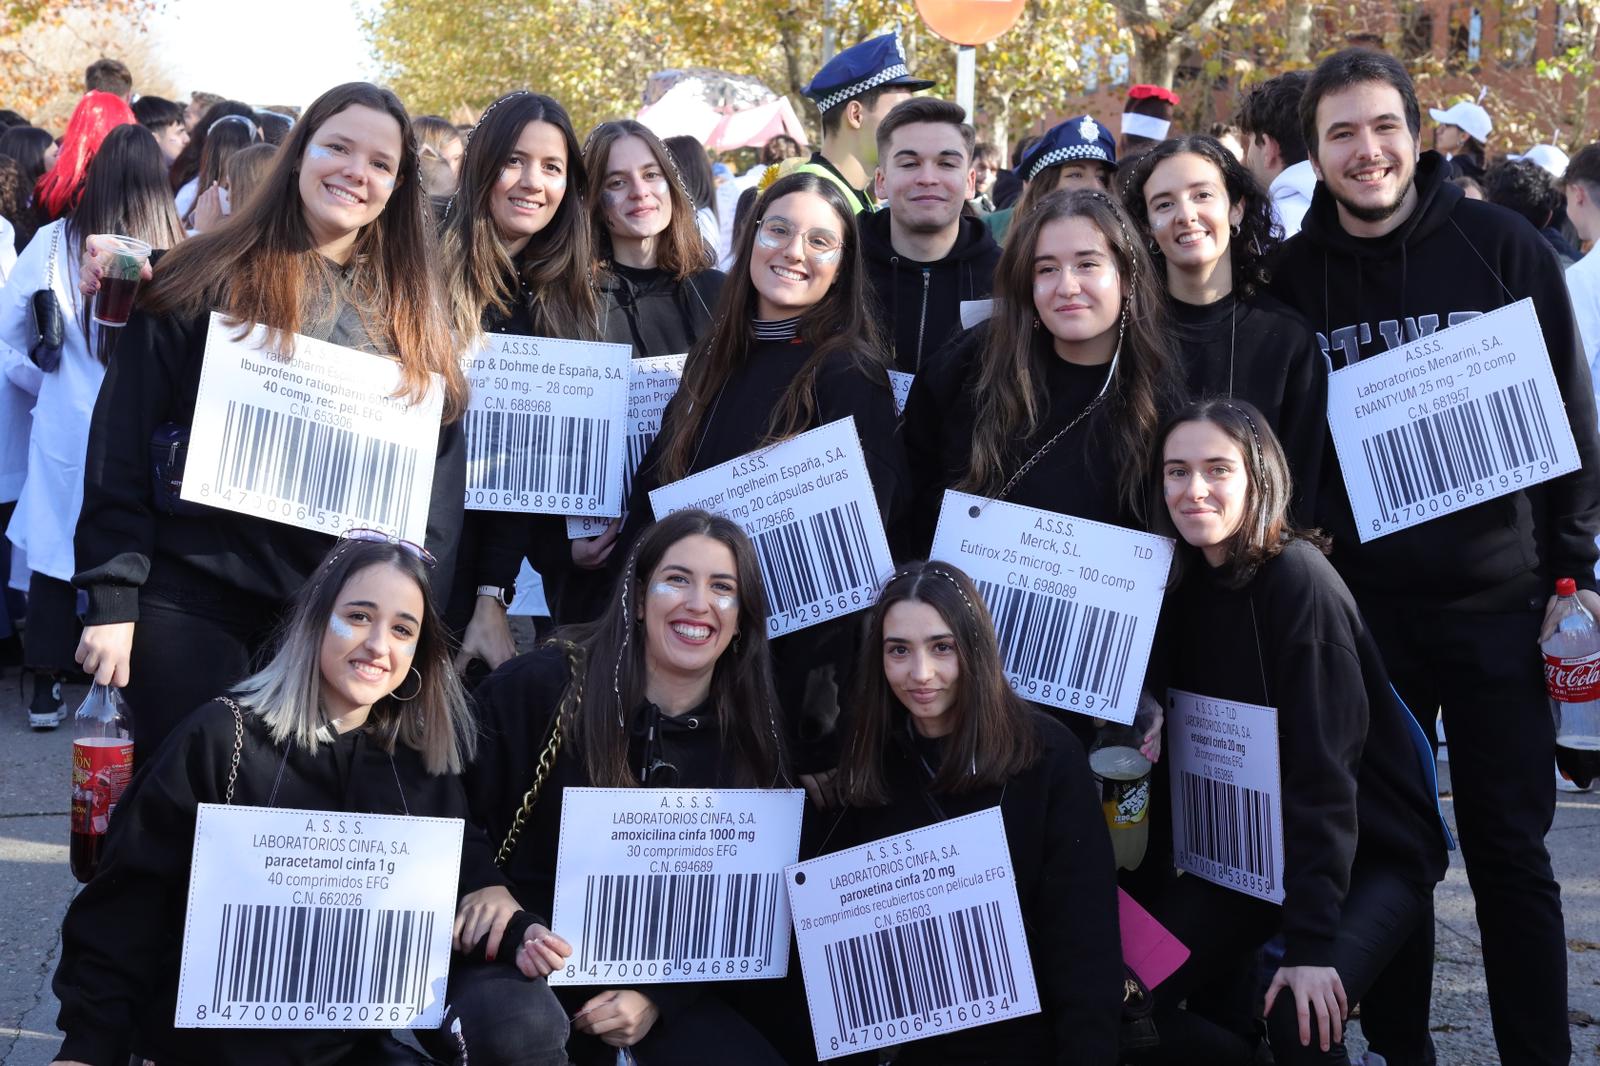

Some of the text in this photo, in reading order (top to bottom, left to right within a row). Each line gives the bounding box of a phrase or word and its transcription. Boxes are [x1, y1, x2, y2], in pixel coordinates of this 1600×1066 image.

[501, 342, 540, 356] A.S.S.S.
[1406, 340, 1443, 362] A.S.S.S.
[488, 359, 496, 370] &
[500, 359, 539, 373] Dohme
[542, 362, 556, 374] de
[560, 364, 601, 380] España,
[605, 368, 624, 379] S.A.
[1357, 335, 1502, 398] Laboratorios Menarini, S.A.
[240, 358, 303, 384] Ibuprofeno
[305, 378, 365, 401] ratiopharm
[494, 378, 509, 389] 50
[512, 381, 532, 394] mg.
[546, 382, 560, 394] 28
[563, 384, 594, 398] comp
[1355, 386, 1417, 418] ENANTYUM
[1419, 383, 1434, 394] 25
[1435, 377, 1454, 391] mg
[1467, 364, 1482, 377] 20
[1485, 352, 1516, 375] comp
[263, 381, 277, 393] 40
[280, 386, 313, 406] comp.
[316, 395, 337, 409] rec.
[339, 402, 359, 418] pel.
[485, 397, 551, 412] C.N. 688968
[1408, 387, 1470, 420] C.N. 681957
[290, 404, 352, 429] C.N. 653306
[638, 421, 658, 432] C.N.
[732, 457, 768, 479] A.S.S.S.
[669, 447, 847, 516] hringer Ingelheim España, S.A.
[732, 506, 749, 522] mg
[751, 497, 764, 514] 20
[766, 482, 815, 508] cápsulas
[816, 469, 848, 490] duras
[1034, 518, 1074, 537] A.S.S.S.
[1020, 532, 1081, 557] Merck, S.L.
[1133, 545, 1152, 560] TLD
[960, 540, 1000, 561] Eutirox
[1002, 550, 1017, 564] 25
[1020, 555, 1062, 576] microg.
[1079, 566, 1099, 582] 100
[1102, 574, 1135, 591] comp
[1007, 572, 1077, 599] C.N. 698089
[1213, 737, 1226, 749] cinfa
[1228, 740, 1235, 751] 20
[1236, 744, 1245, 756] mg
[613, 813, 756, 825] LABORATORIOS CINFA, S.A.
[253, 835, 410, 855] LABORATORIOS CINFA, S.A.
[611, 829, 755, 842] amoxicilina cinfa 1000 mg
[265, 855, 343, 870] paracetamol
[346, 858, 376, 870] cinfa
[627, 845, 737, 858] 30 comprimidos EFG
[650, 861, 713, 872] C.N. 694689
[830, 844, 960, 890] LABORATORIOS CINFA, S.A.
[268, 873, 389, 889] 40 comprimidos EFG
[840, 864, 955, 906] paroxetina cinfa 20 mg
[293, 892, 362, 906] C.N. 662026
[801, 866, 1005, 930] 28 comprimidos recubiertos con película EFG
[874, 903, 931, 929] C.N. 651603
